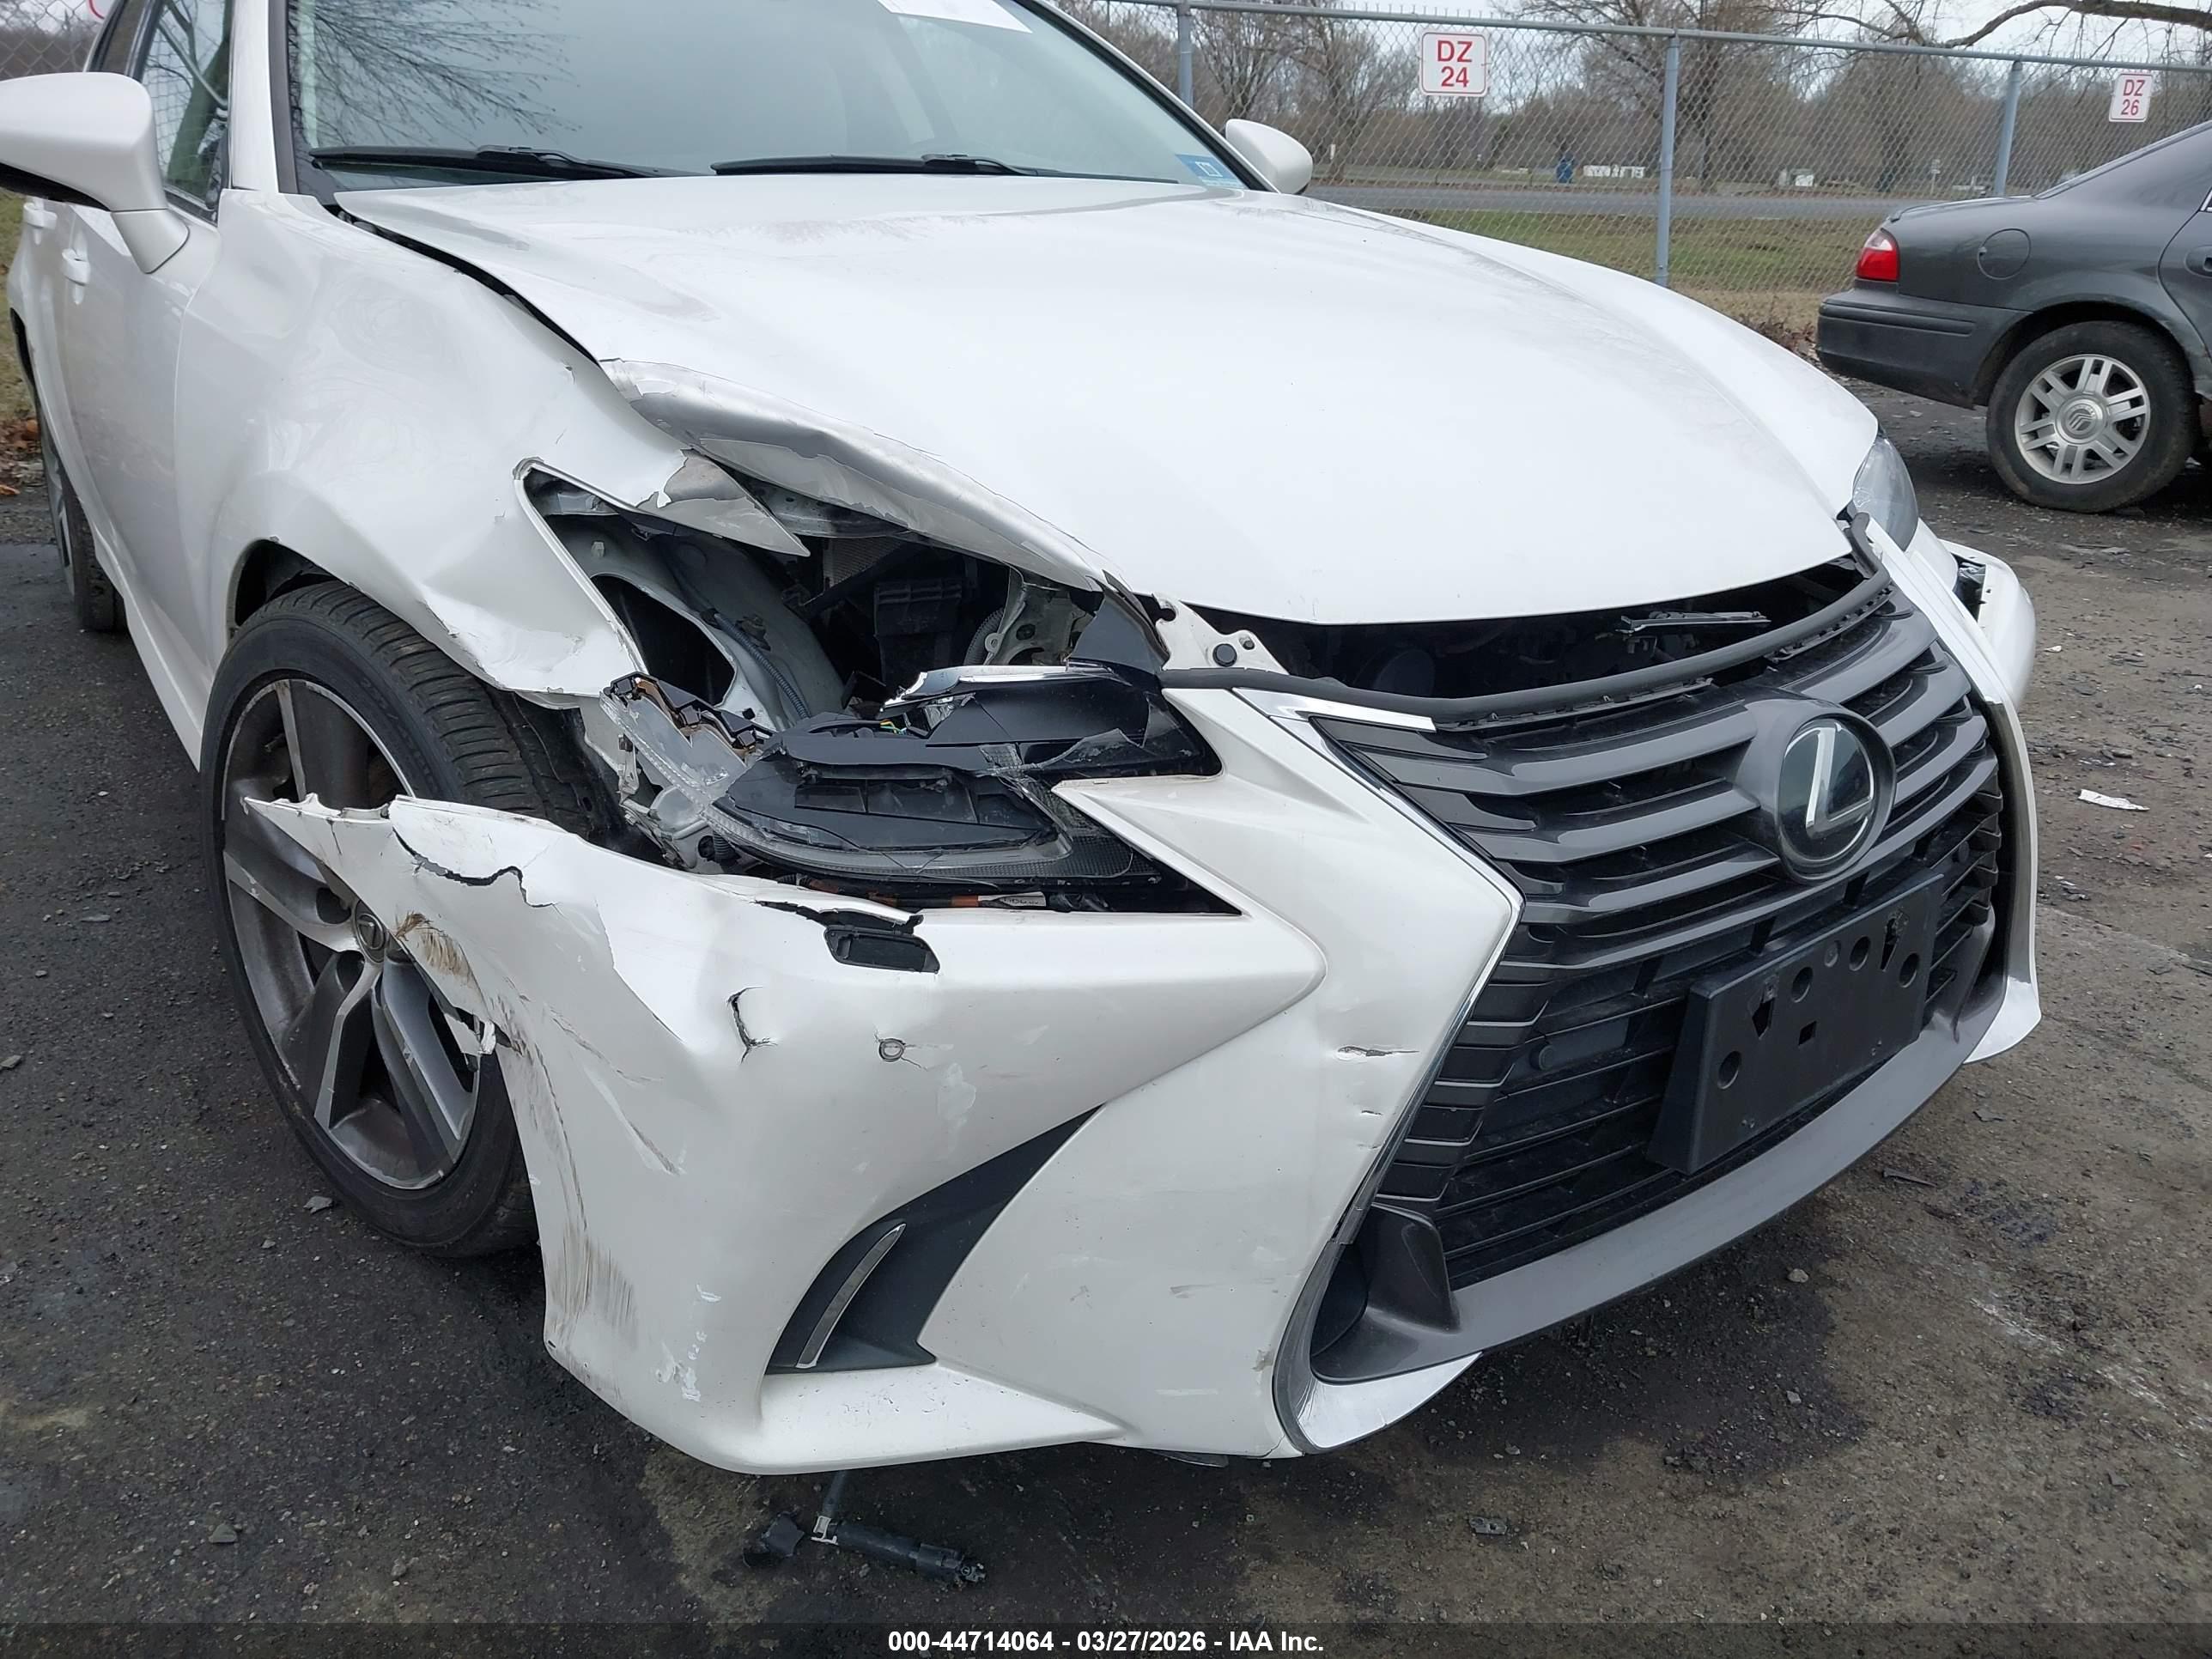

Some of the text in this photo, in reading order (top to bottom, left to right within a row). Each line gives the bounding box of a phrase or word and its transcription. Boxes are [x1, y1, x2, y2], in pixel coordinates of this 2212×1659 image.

[1437, 40, 1473, 63] DZ
[1441, 65, 1469, 88] 24
[2123, 79, 2146, 96] DZ
[2120, 99, 2140, 116] 26
